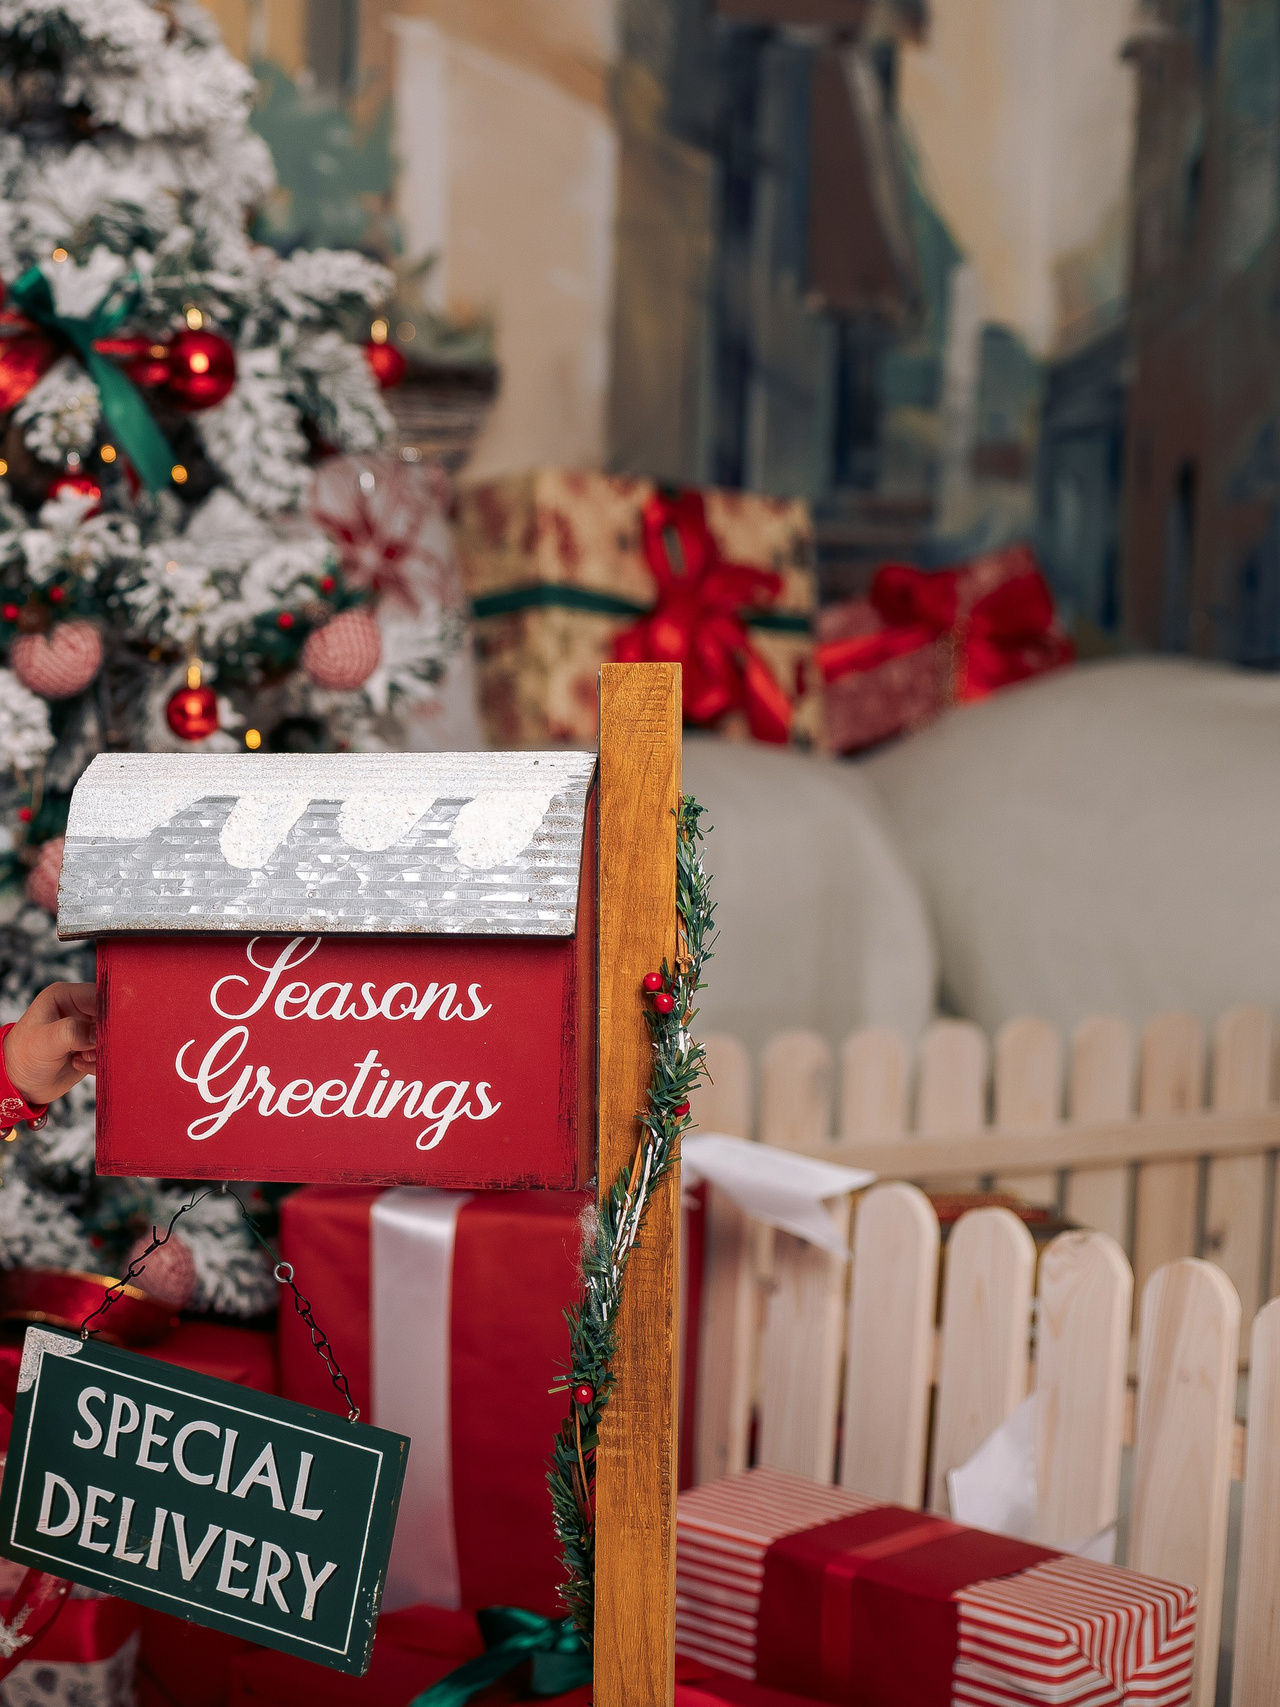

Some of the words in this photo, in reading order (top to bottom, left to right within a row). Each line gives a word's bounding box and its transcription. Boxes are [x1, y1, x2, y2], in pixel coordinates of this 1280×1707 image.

[210, 936, 492, 1021] Seasons
[175, 1025, 501, 1151] Greetings
[72, 1386, 323, 1521] SPECIAL
[35, 1471, 338, 1621] DELIVERY
